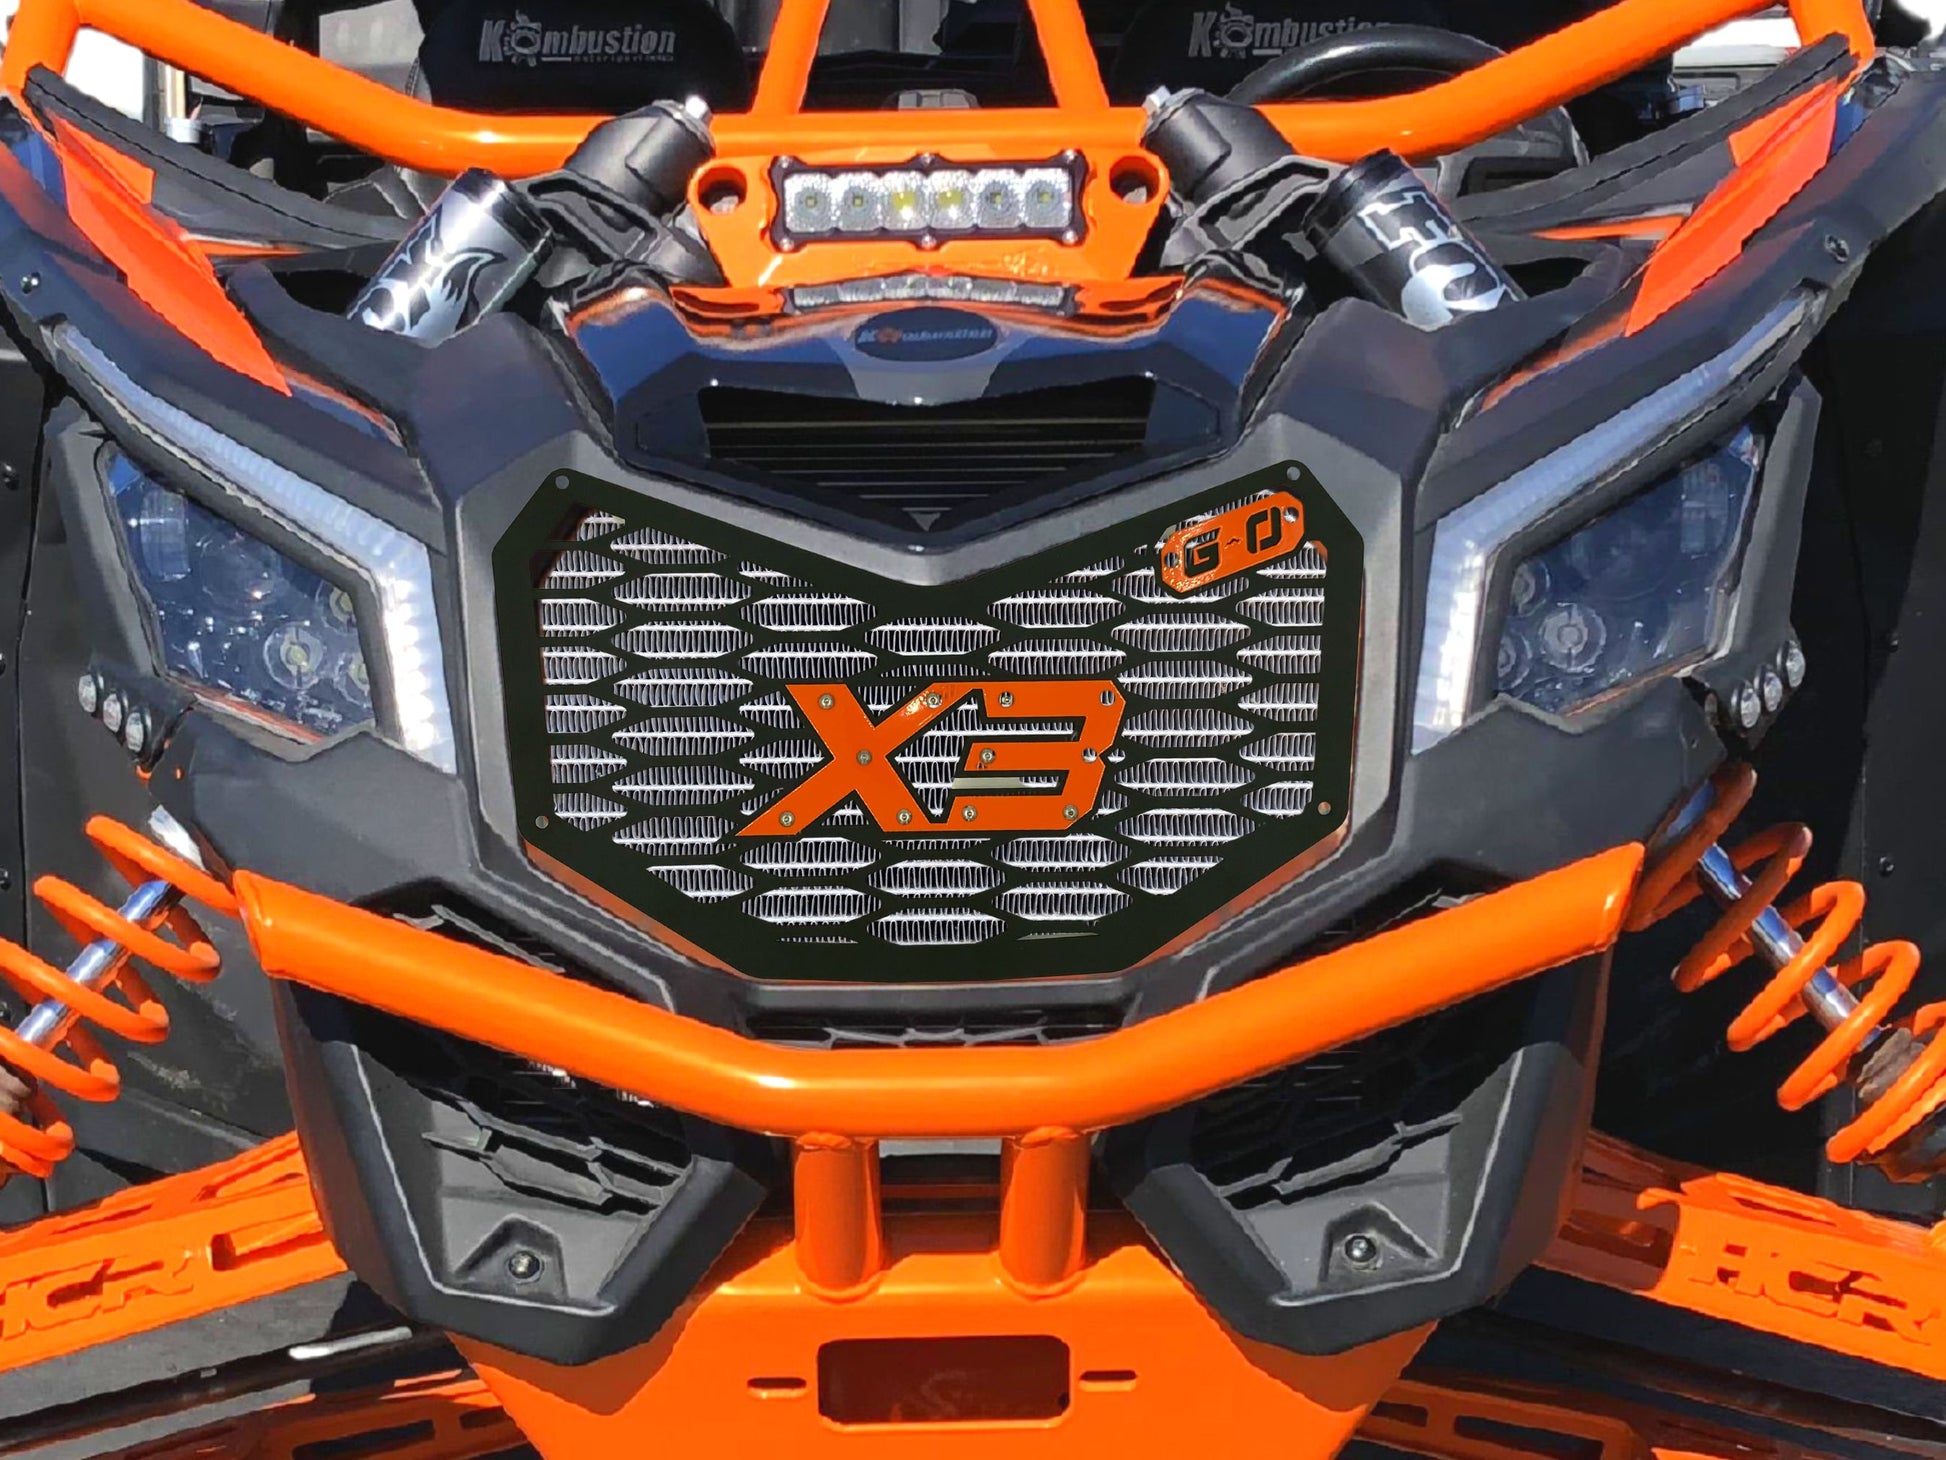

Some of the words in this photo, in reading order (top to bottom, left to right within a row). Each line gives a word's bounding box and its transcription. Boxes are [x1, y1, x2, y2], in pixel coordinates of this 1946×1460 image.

[478, 10, 676, 67] Kombustion
[736, 680, 1127, 836] X3
[1688, 1241, 1938, 1346] HCR
